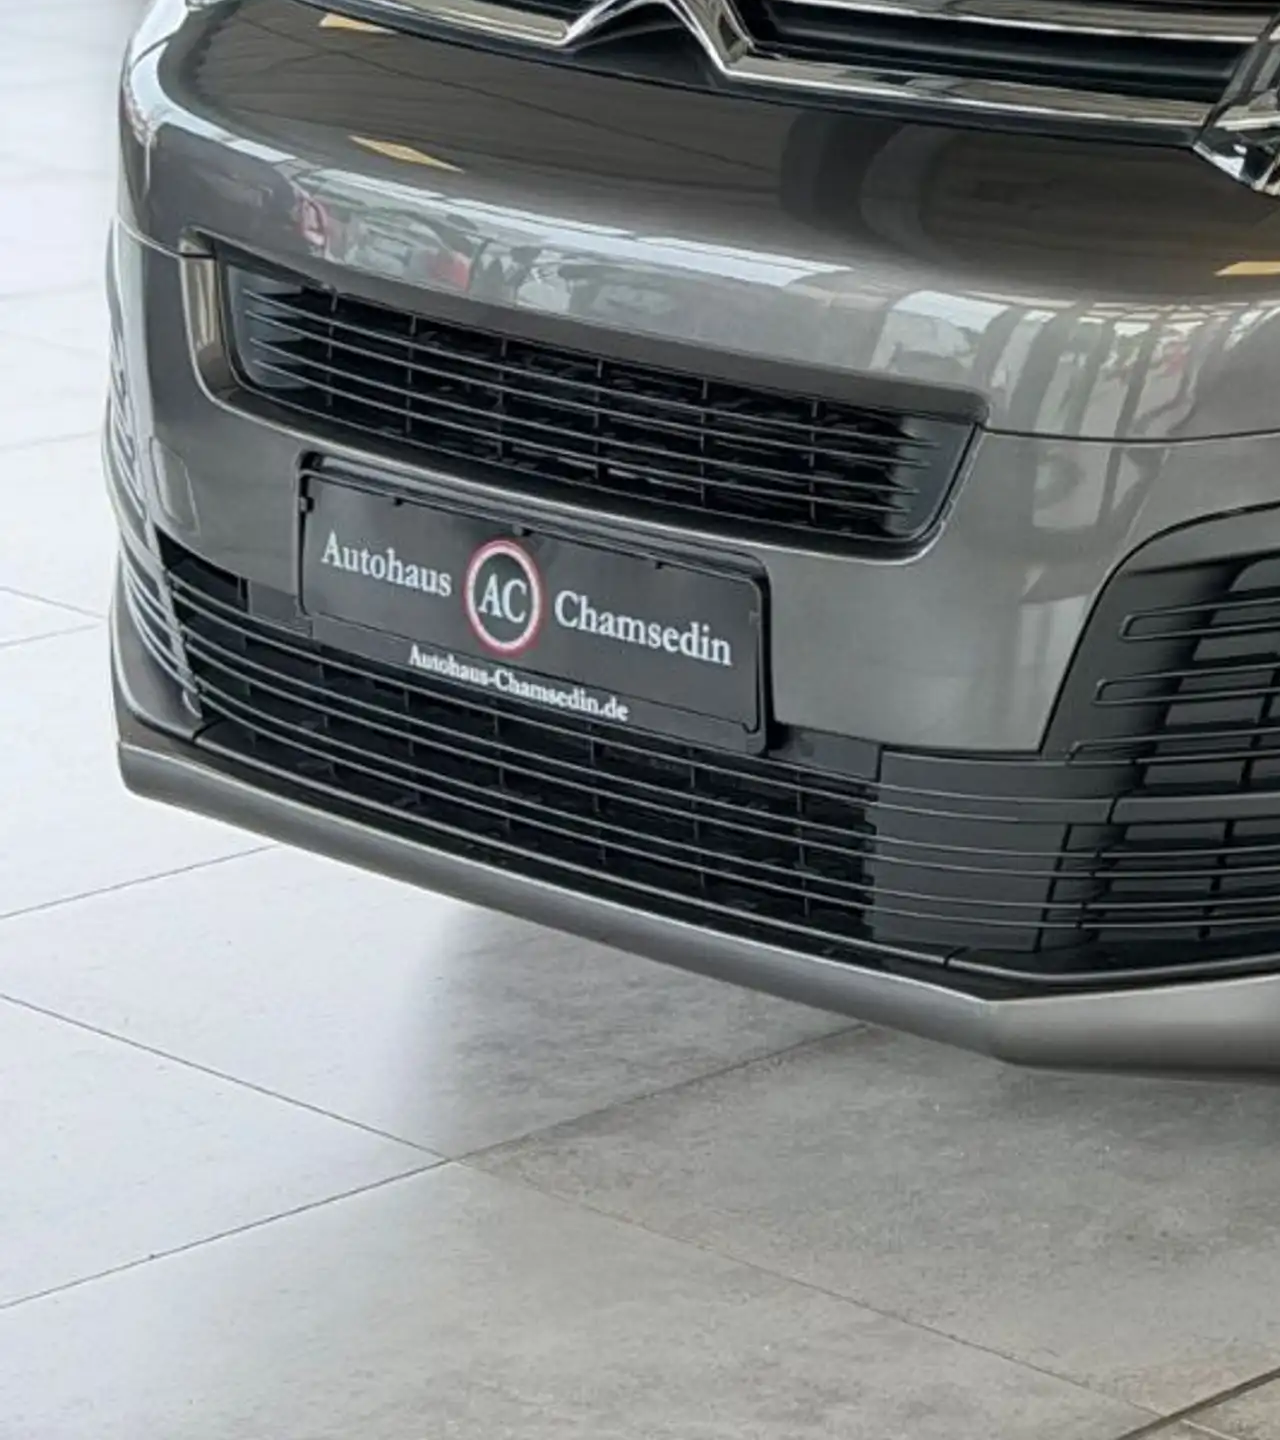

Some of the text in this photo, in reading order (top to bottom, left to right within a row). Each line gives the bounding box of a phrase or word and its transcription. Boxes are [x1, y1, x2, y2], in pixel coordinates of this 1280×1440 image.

[321, 529, 733, 667] Autohaus AC Chamsedin
[408, 645, 630, 723] Autohaus-Chamsedin.de
